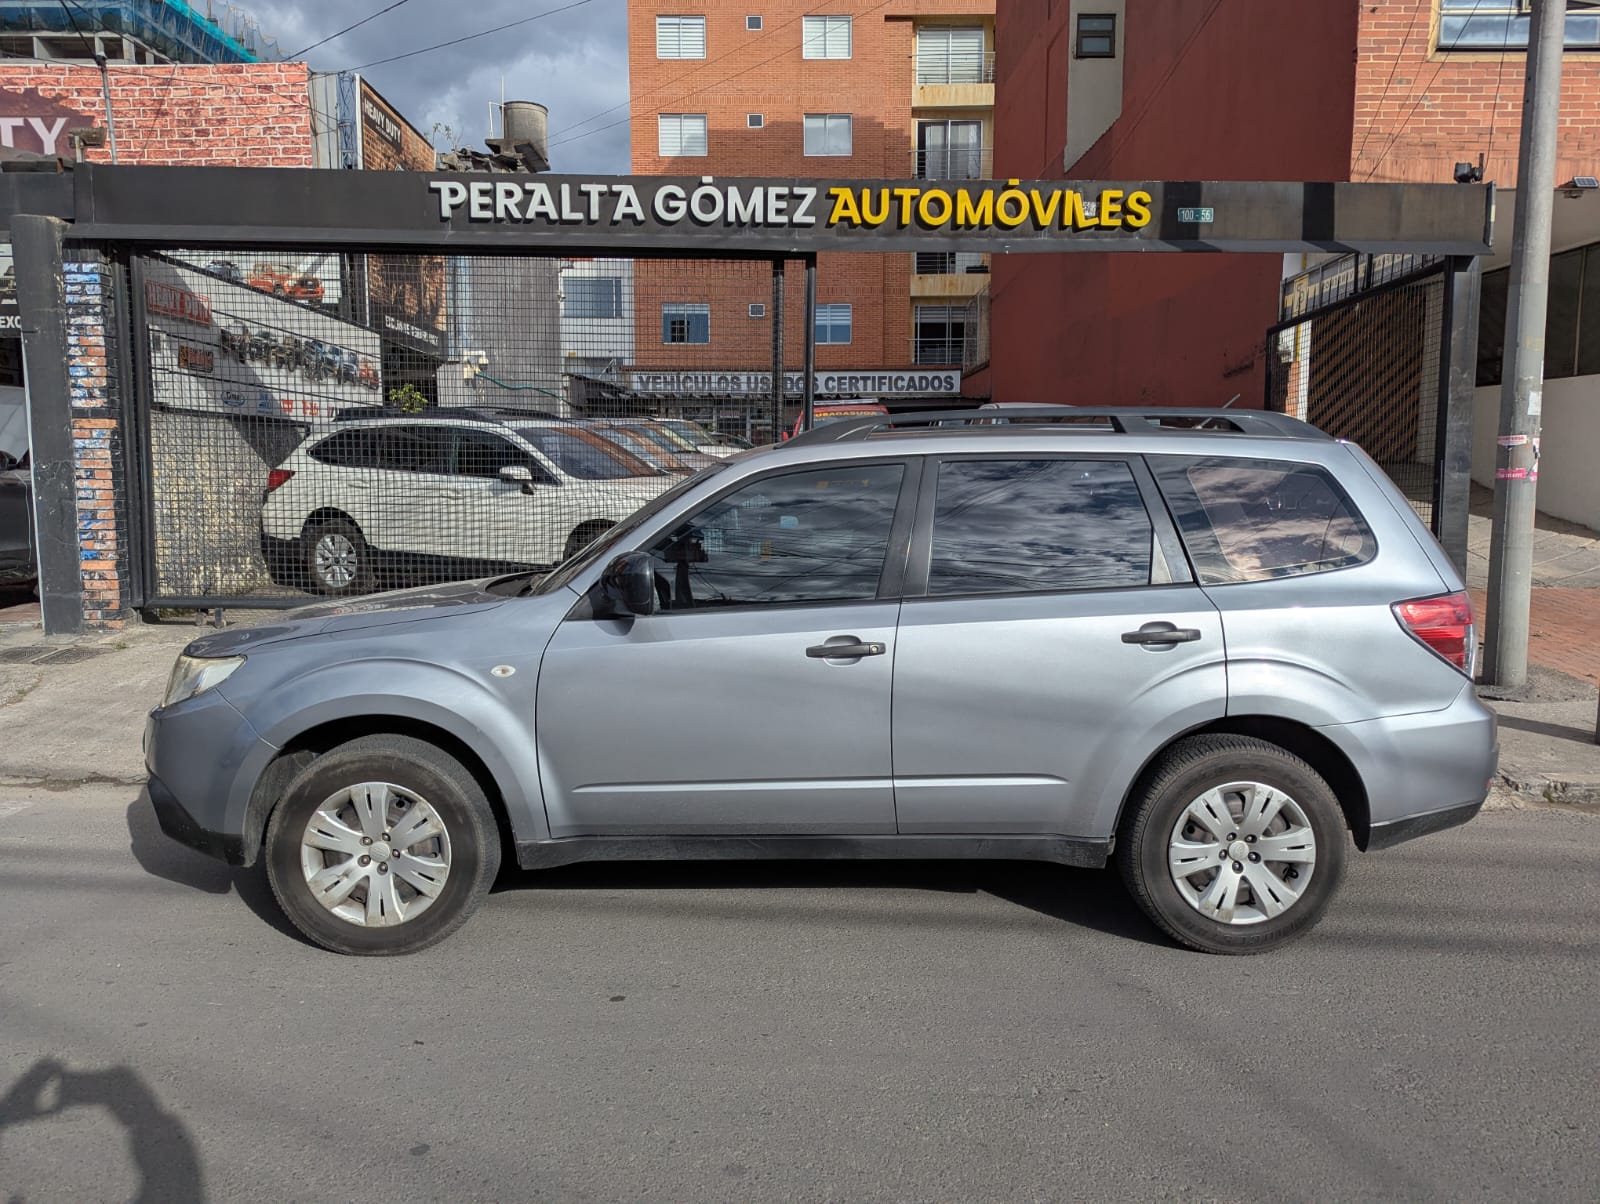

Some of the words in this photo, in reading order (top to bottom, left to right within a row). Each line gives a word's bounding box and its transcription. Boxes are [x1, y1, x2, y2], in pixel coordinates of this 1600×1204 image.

[364, 97, 385, 129] HEAVY
[385, 117, 402, 143] DUTY
[429, 180, 646, 222] PERALTA
[653, 176, 818, 224] GÓMEZ
[828, 178, 1153, 229] AUTOMÓVILES
[746, 375, 819, 392] USDOS
[825, 375, 955, 392] CERTIFICADOS
